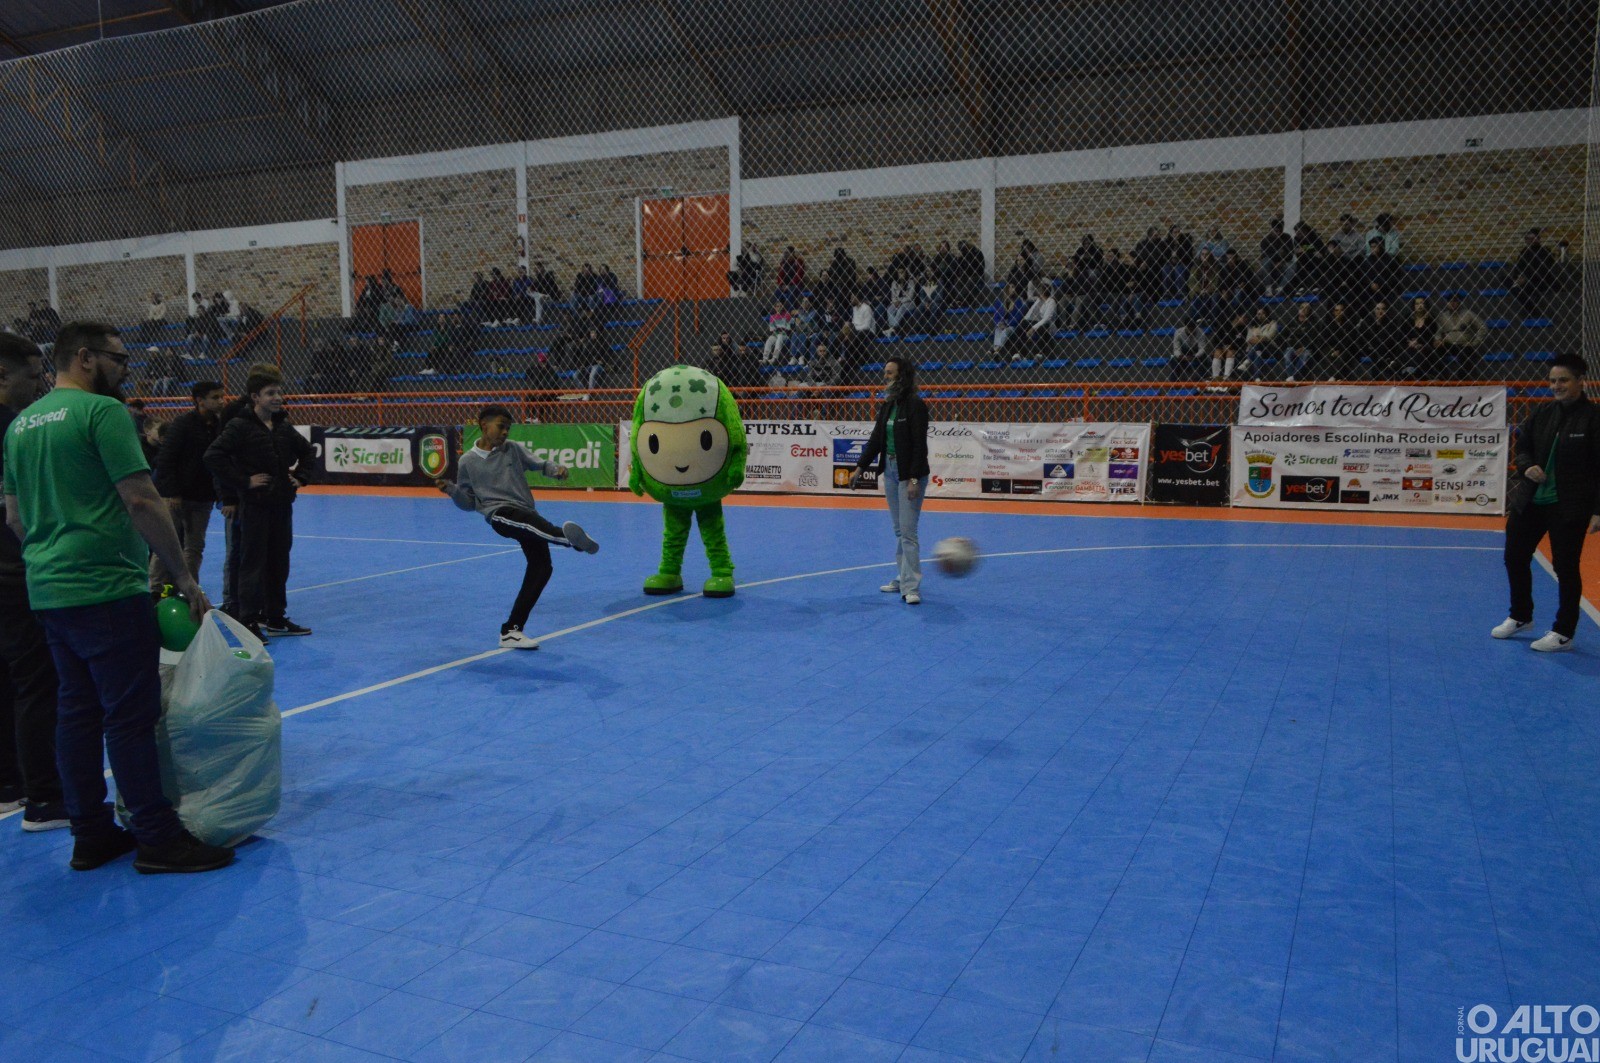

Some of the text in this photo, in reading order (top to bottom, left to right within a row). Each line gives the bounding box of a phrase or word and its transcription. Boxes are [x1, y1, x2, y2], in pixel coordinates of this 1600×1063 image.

[1250, 392, 1495, 423] Somos todos Rodeio
[27, 407, 69, 429] Sicredi
[744, 423, 817, 436] FUTSAL
[1243, 432, 1501, 444] Apoiadores Escolinha Rodeio Futsal
[351, 448, 404, 464] Sicredi
[1298, 455, 1338, 465] Sicredi
[745, 465, 782, 475] MAZZONETTO
[1158, 478, 1220, 487] www.yesbet.bet
[1434, 481, 1464, 491] SENSI
